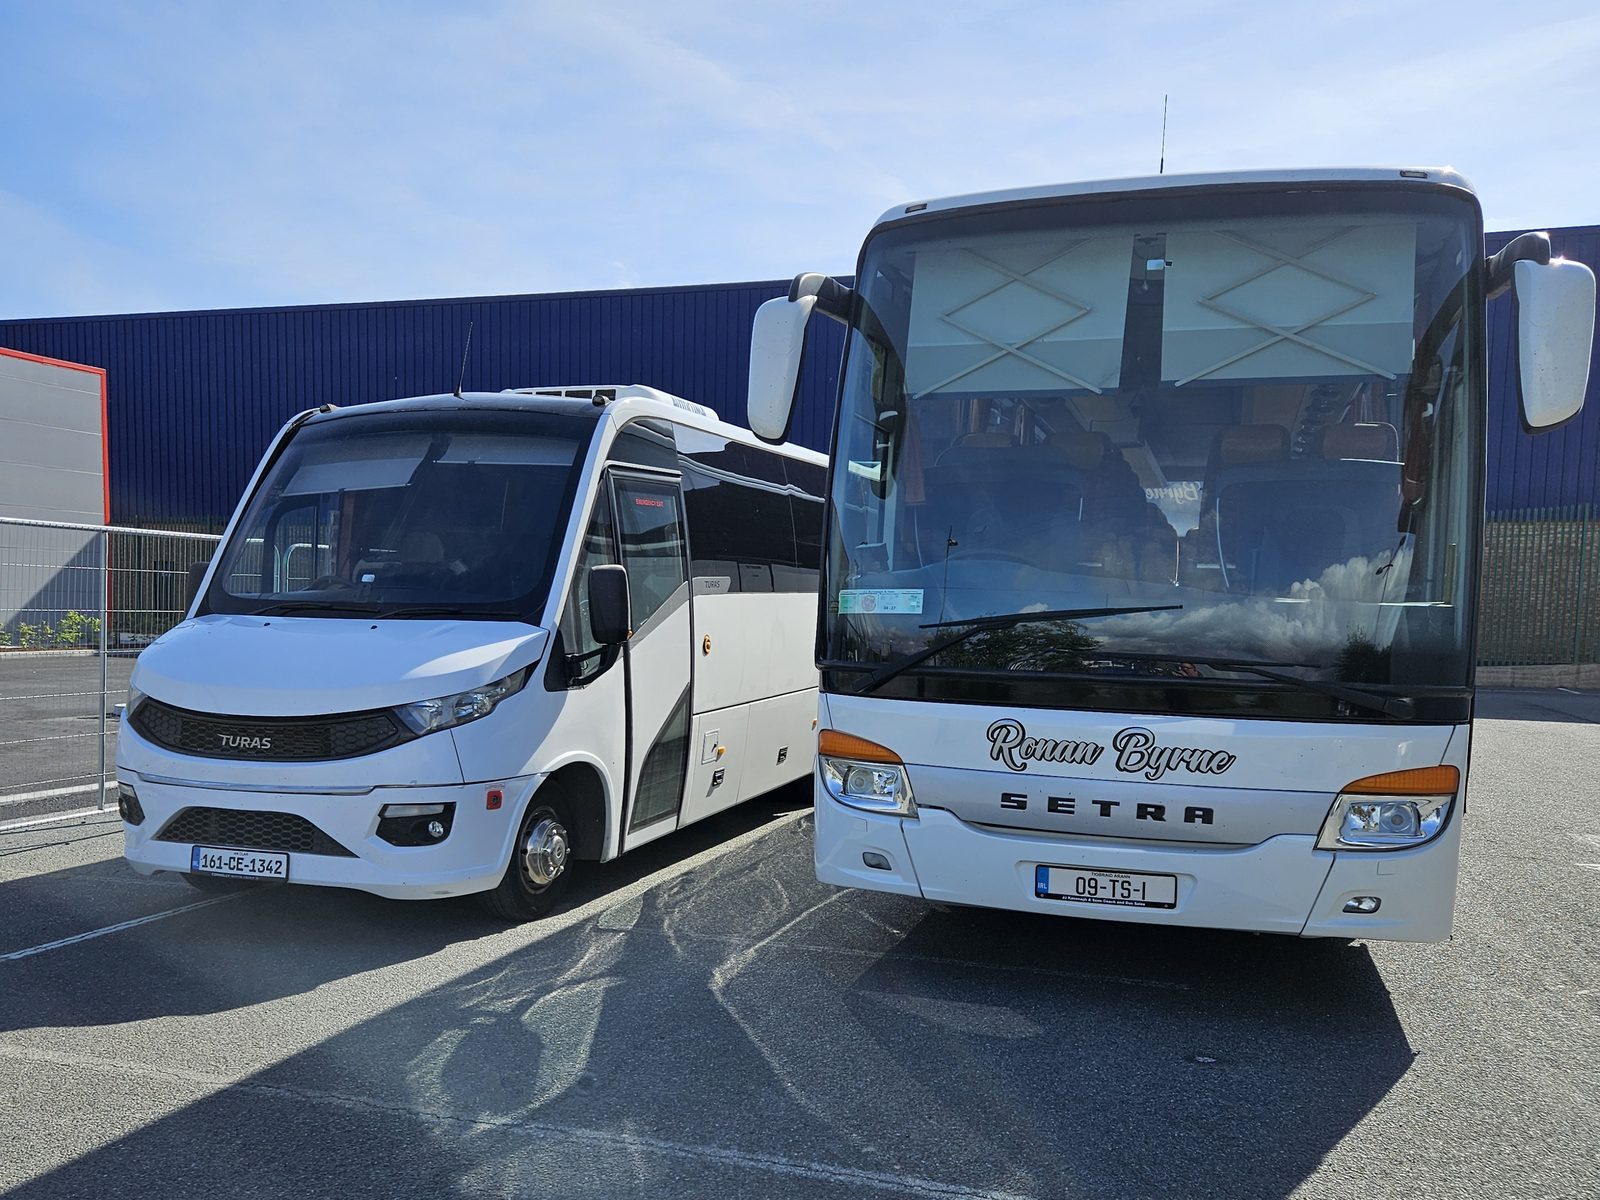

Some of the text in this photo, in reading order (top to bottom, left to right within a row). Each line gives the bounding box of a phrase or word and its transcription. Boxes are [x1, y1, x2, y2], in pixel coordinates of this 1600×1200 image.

[704, 580, 720, 589] TURAS
[217, 733, 271, 749] TURAS
[986, 718, 1236, 781] Ronan Byrne
[1000, 792, 1214, 825] SETRA
[201, 854, 283, 875] 161-CE-1342
[1037, 882, 1047, 890] IRL
